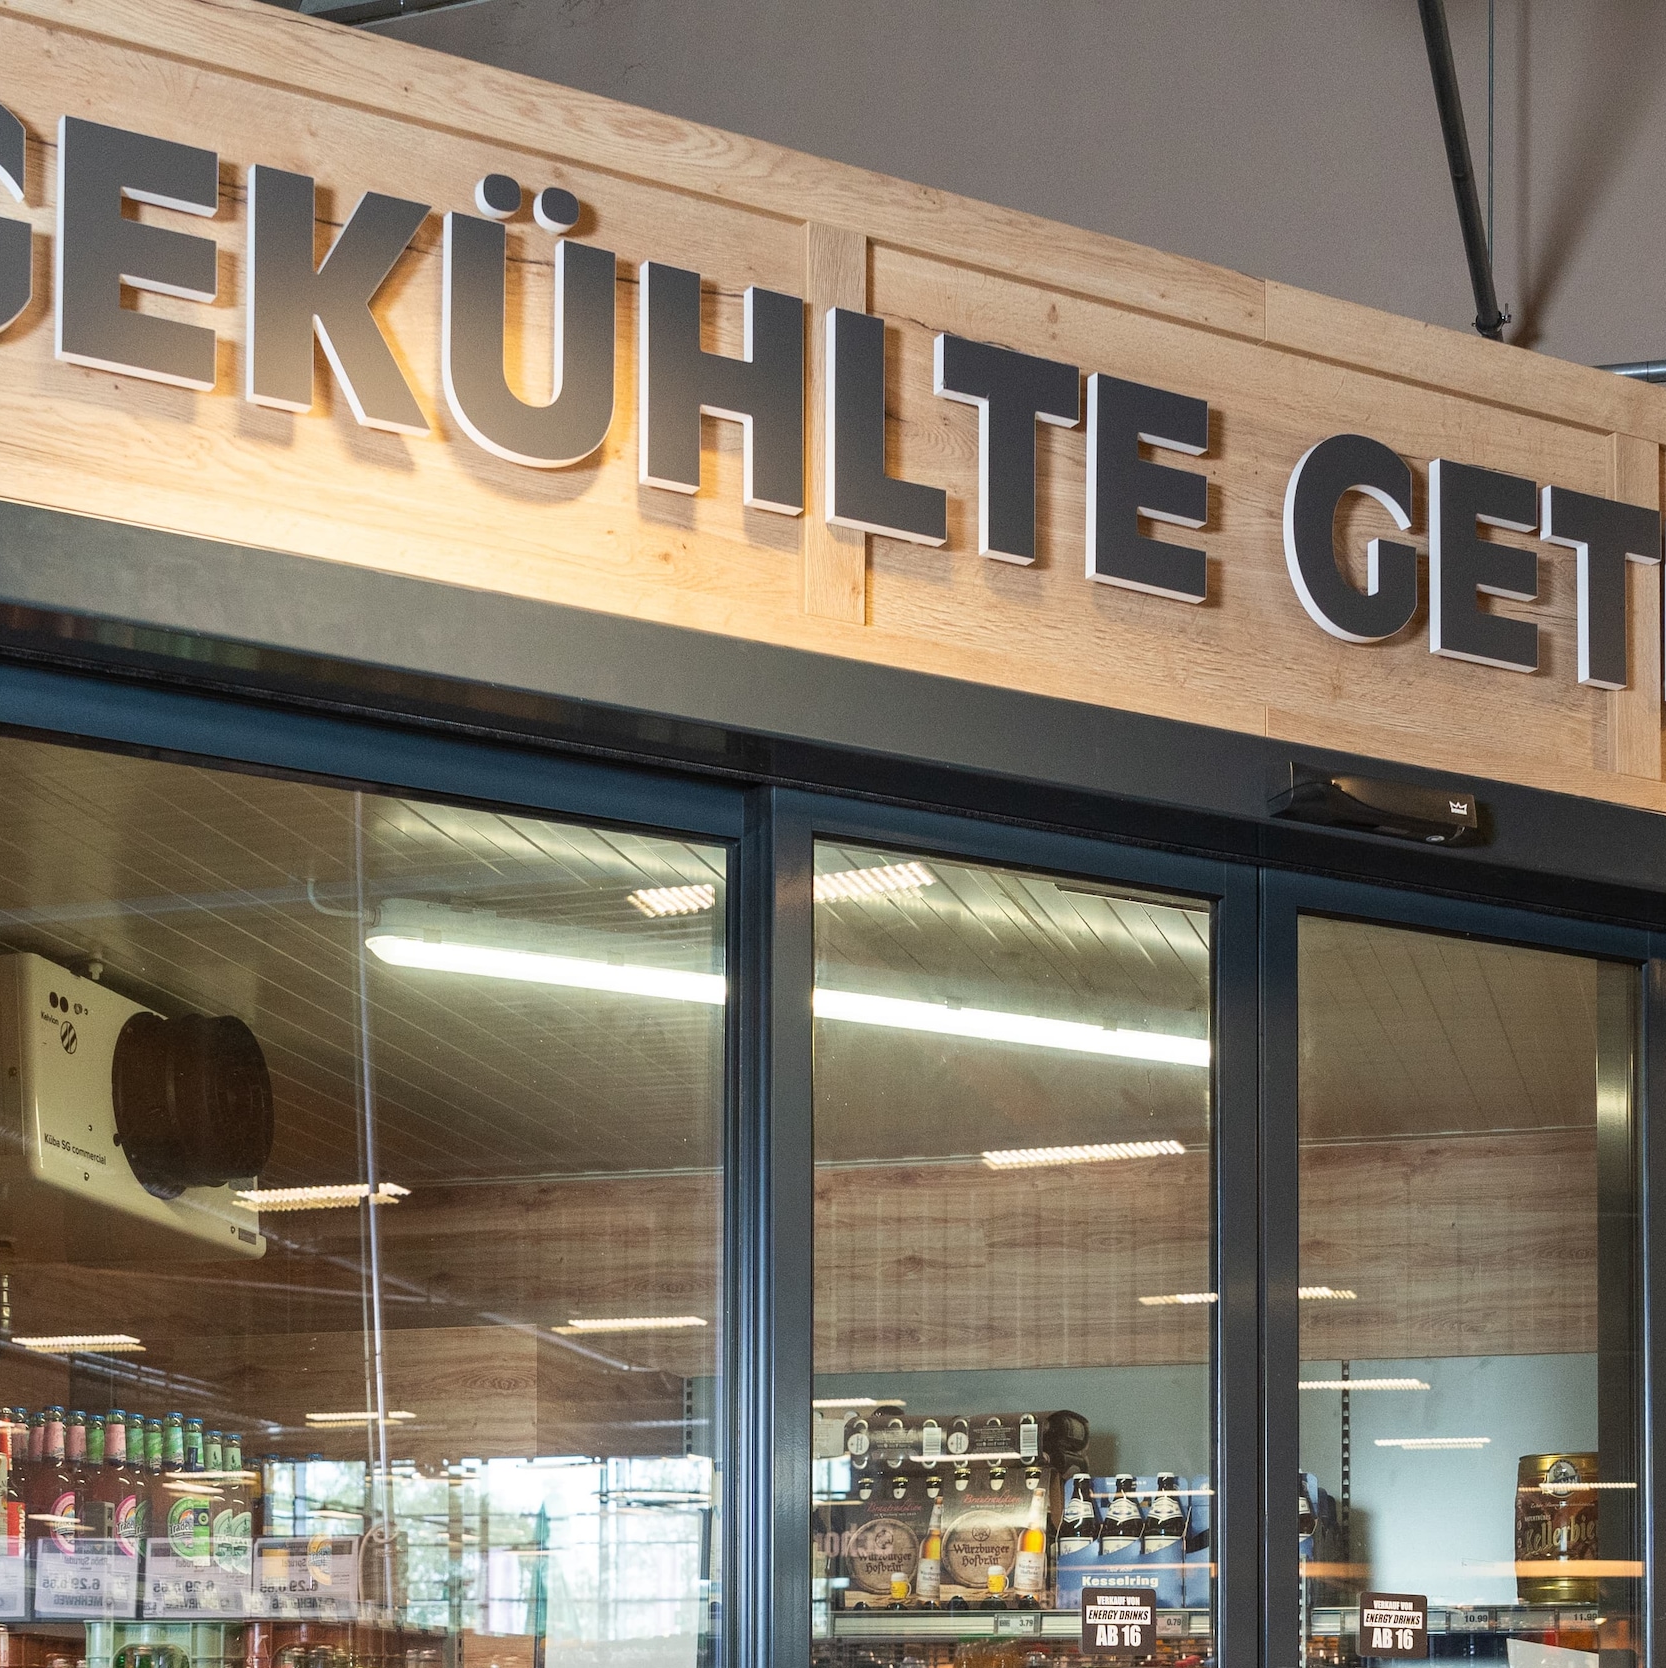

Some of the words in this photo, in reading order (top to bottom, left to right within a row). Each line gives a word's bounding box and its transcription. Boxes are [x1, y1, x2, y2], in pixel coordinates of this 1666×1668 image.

[44, 1133, 61, 1148] Küba
[61, 1139, 71, 1152] SG
[72, 1145, 107, 1166] commercial
[952, 1541, 1010, 1557] Würzburger
[961, 1554, 1001, 1568] Hofbräu
[1082, 1574, 1159, 1588] Kesselring
[1096, 1595, 1125, 1606] VERKAUF
[1126, 1595, 1140, 1606] VON
[1373, 1600, 1398, 1610] VERKAUF
[1399, 1600, 1414, 1610] VON
[1088, 1609, 1118, 1620] ENERGY
[1120, 1609, 1149, 1621] DRINKS
[1365, 1612, 1393, 1624] ENERGY
[1394, 1614, 1421, 1625] DRINKS
[1464, 1614, 1488, 1623] 10.99
[1096, 1625, 1118, 1647] AB
[1121, 1625, 1141, 1647] 16
[1372, 1627, 1393, 1648] AB
[1395, 1628, 1414, 1649] 16
